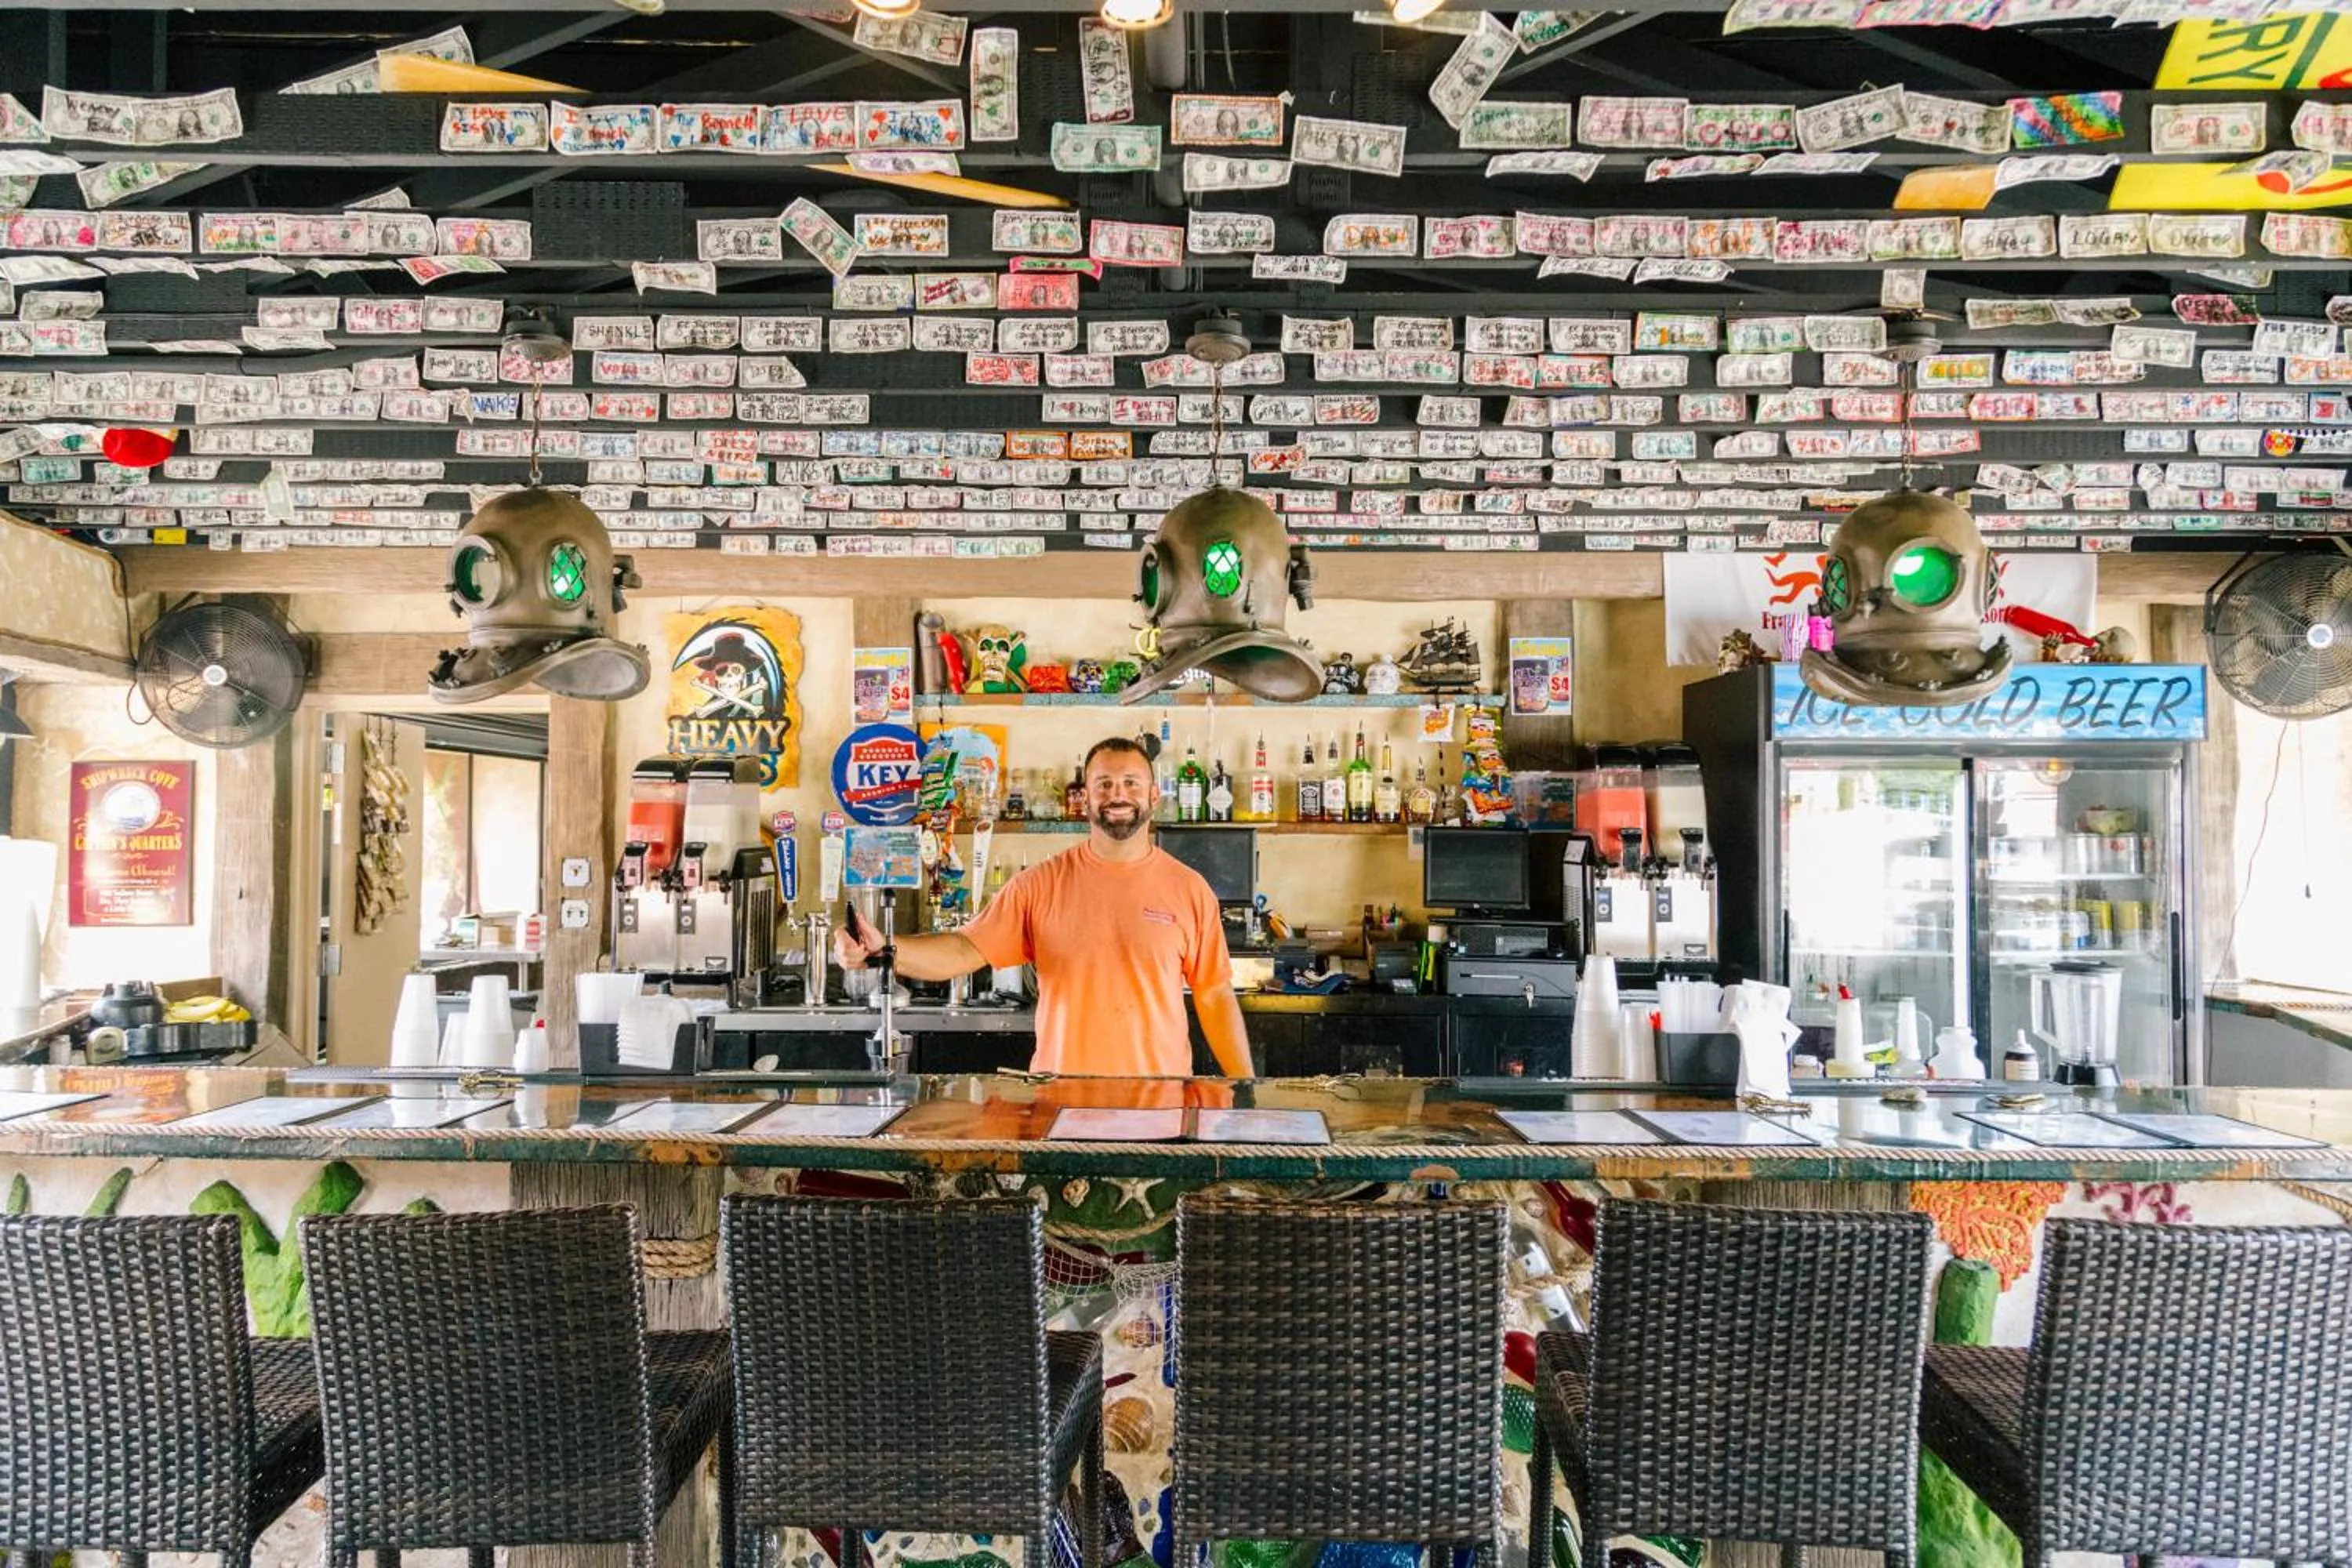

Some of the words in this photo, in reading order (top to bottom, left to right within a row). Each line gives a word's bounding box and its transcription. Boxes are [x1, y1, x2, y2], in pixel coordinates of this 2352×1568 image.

[2056, 676, 2192, 729] BEER
[671, 719, 787, 753] HEAVY
[856, 764, 911, 786] KEY
